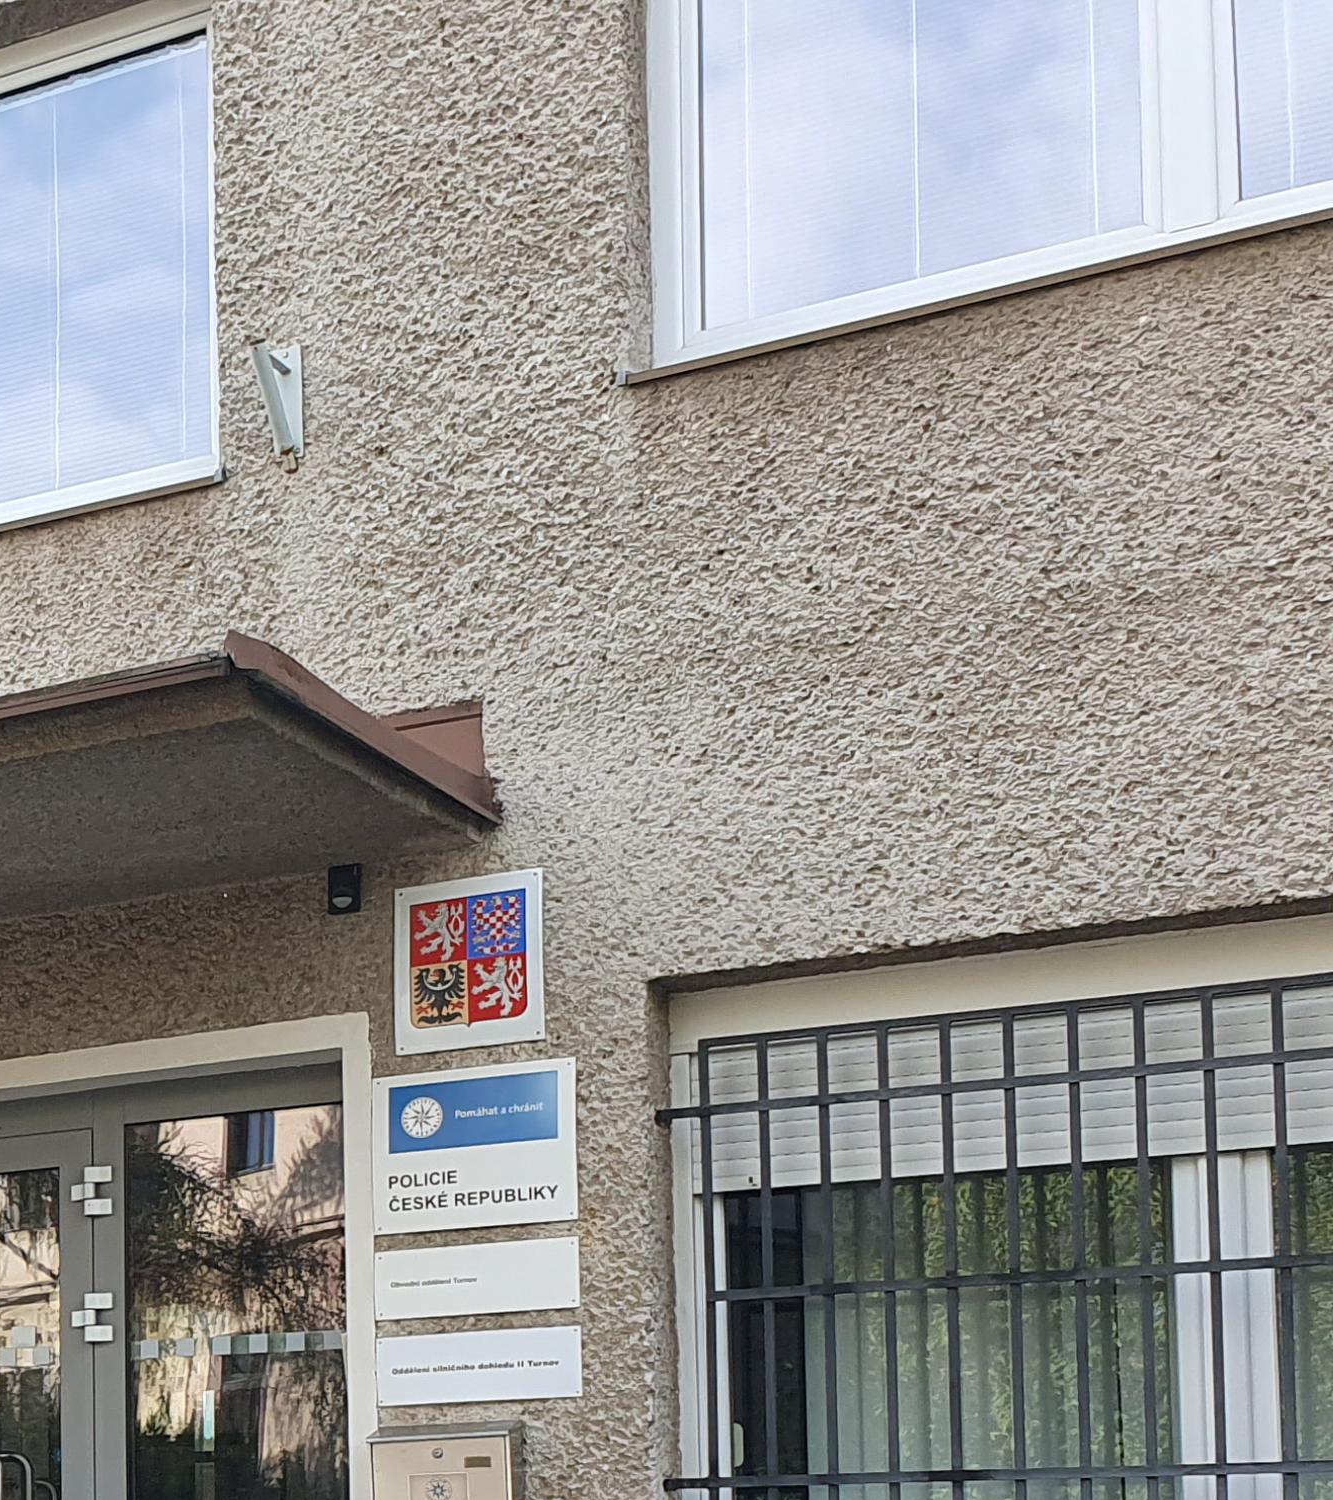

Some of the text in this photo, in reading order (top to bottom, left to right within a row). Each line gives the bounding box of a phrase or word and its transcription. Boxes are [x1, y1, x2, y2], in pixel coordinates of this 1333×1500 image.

[454, 1106, 499, 1119] Pomáhat
[508, 1101, 544, 1113] chránit
[388, 1170, 458, 1190] POLICIE
[389, 1185, 558, 1212] ČESKÉ REPUBLIKY
[453, 1276, 478, 1284] Turnov
[391, 1366, 430, 1375] Oddělení
[432, 1363, 475, 1373] silničního
[477, 1361, 515, 1370] dohledu
[527, 1359, 560, 1368] Turnov
